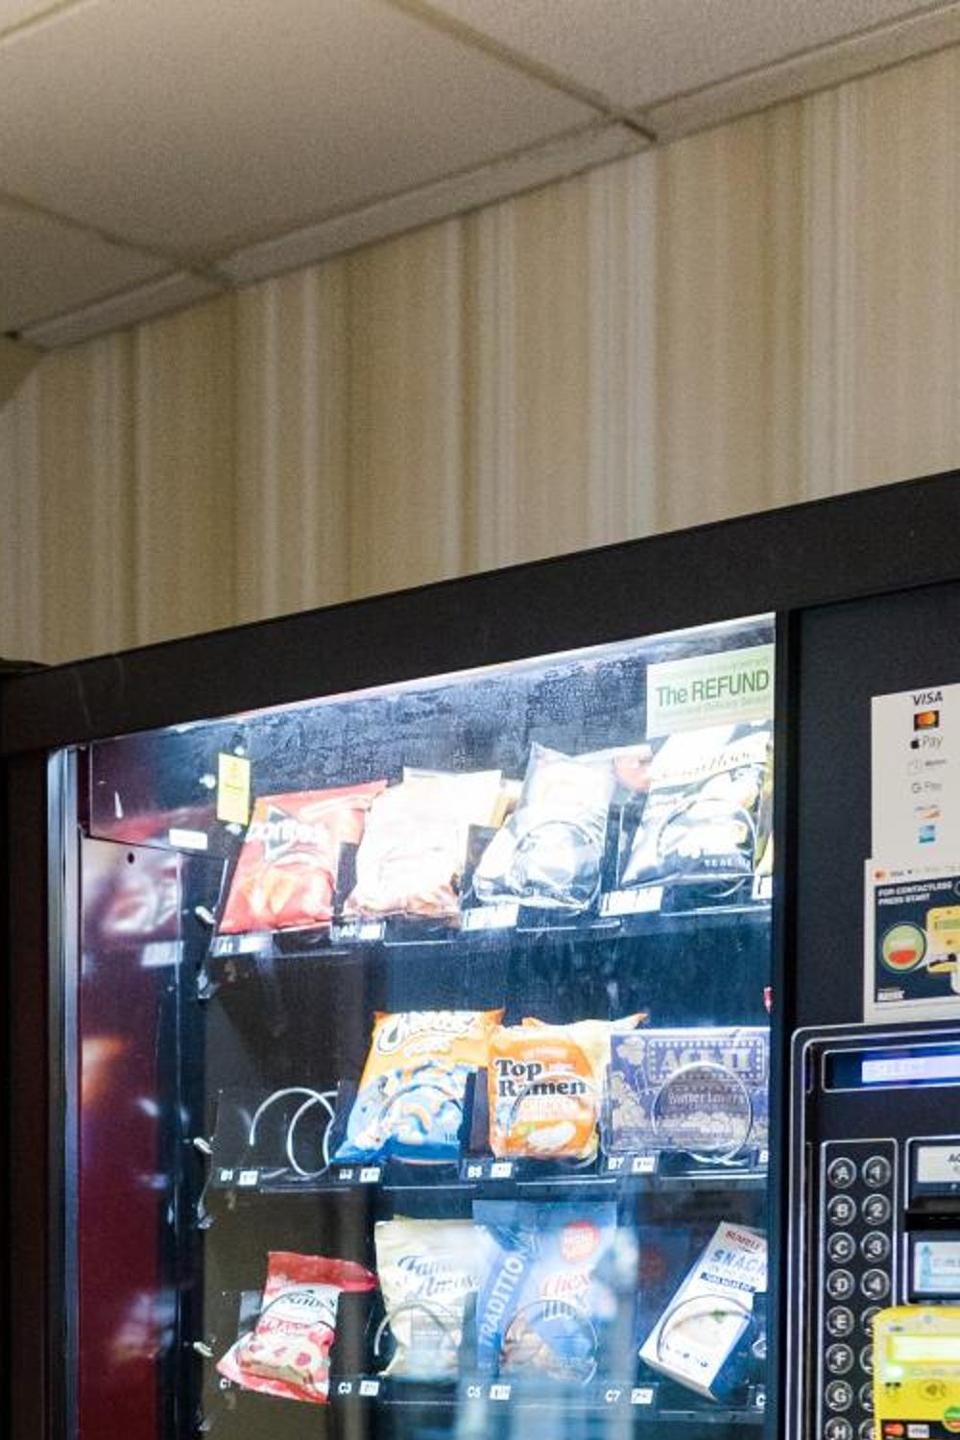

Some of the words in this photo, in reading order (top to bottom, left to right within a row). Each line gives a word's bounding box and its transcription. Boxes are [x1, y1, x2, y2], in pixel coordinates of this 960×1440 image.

[655, 685, 688, 708] The
[692, 669, 770, 701] REFUND
[912, 691, 944, 706] VISA
[495, 1059, 542, 1081] Top
[838, 1166, 849, 1180] A
[871, 1166, 881, 1179] 1
[837, 1204, 849, 1218] B
[872, 1203, 883, 1217] 2
[837, 1241, 848, 1254] C
[871, 1240, 882, 1254] 3
[837, 1278, 848, 1292] D
[871, 1277, 882, 1291] 4
[836, 1315, 847, 1329] E
[835, 1352, 846, 1365] F
[834, 1388, 846, 1402] G
[835, 1425, 846, 1439] H
